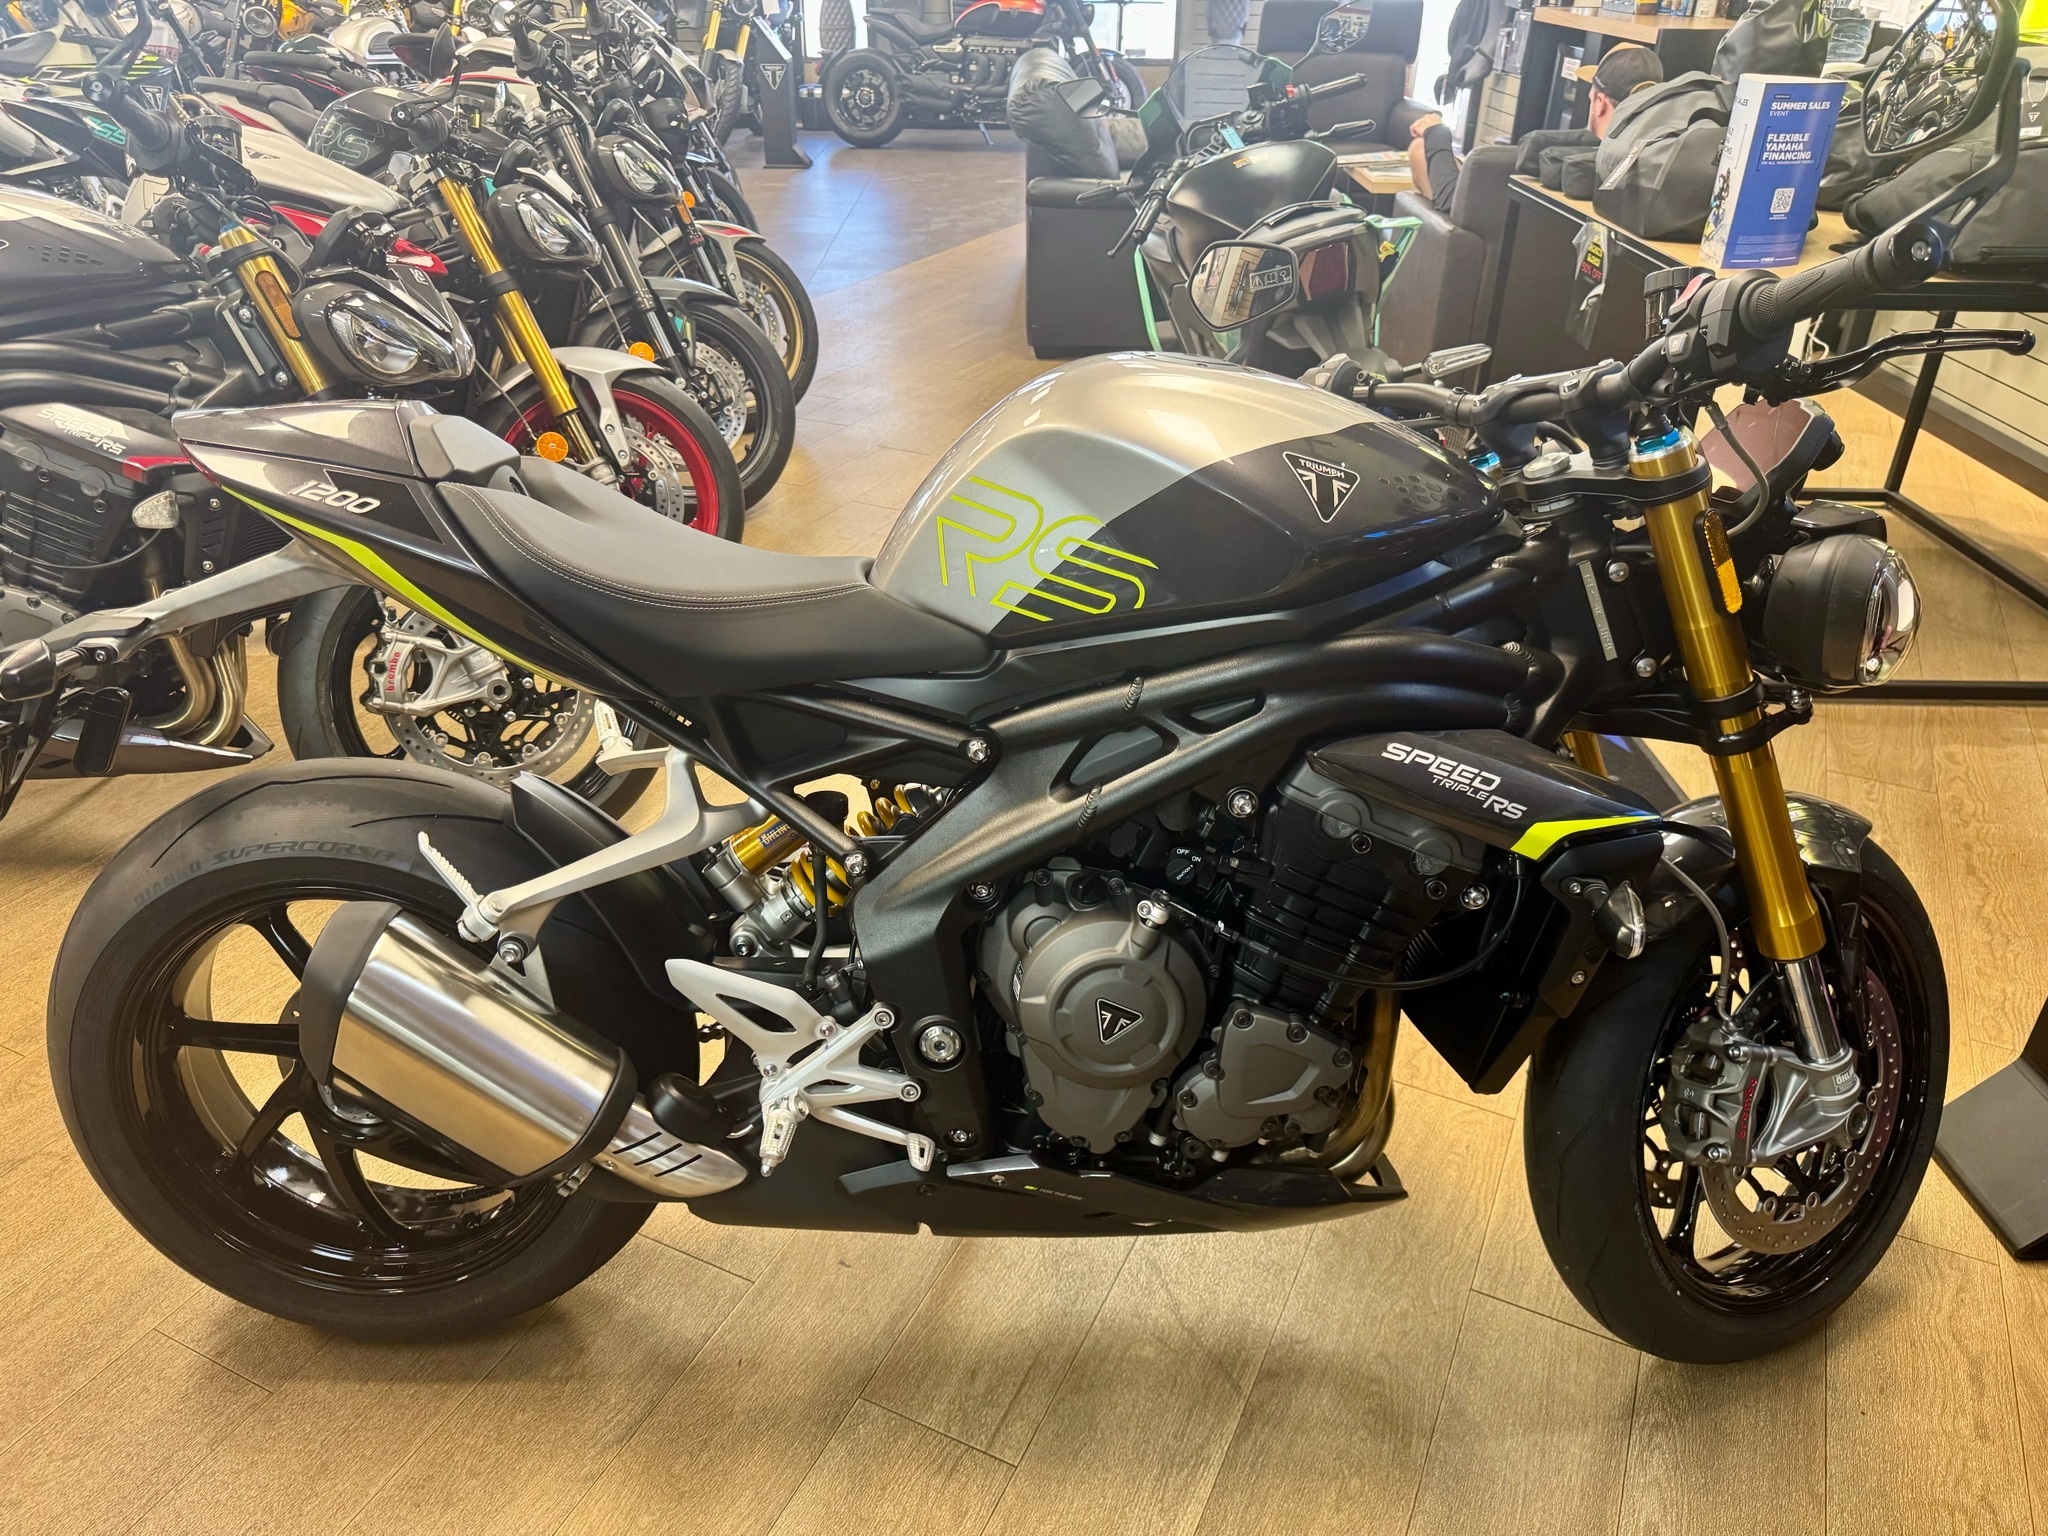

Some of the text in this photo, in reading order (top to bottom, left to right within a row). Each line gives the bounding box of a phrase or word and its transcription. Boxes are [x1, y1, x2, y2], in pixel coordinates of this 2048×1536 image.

[1771, 101, 1831, 111] SUMMER SALES
[1765, 142, 1804, 151] YAMAHA
[1767, 133, 1810, 142] FLEXIBLE
[1762, 151, 1812, 161] FINANCING
[36, 408, 114, 437] SPEED
[63, 427, 127, 456] TRIPLE RS
[1298, 458, 1345, 479] TRIUMPH
[287, 480, 381, 514] 1200
[937, 475, 1160, 622] RS
[385, 651, 402, 693] brembo
[1380, 742, 1503, 792] SPEED
[1432, 774, 1529, 820] TRIPLE RS
[211, 840, 397, 867] SUPERCORSA
[1737, 1077, 1758, 1139] brembo
